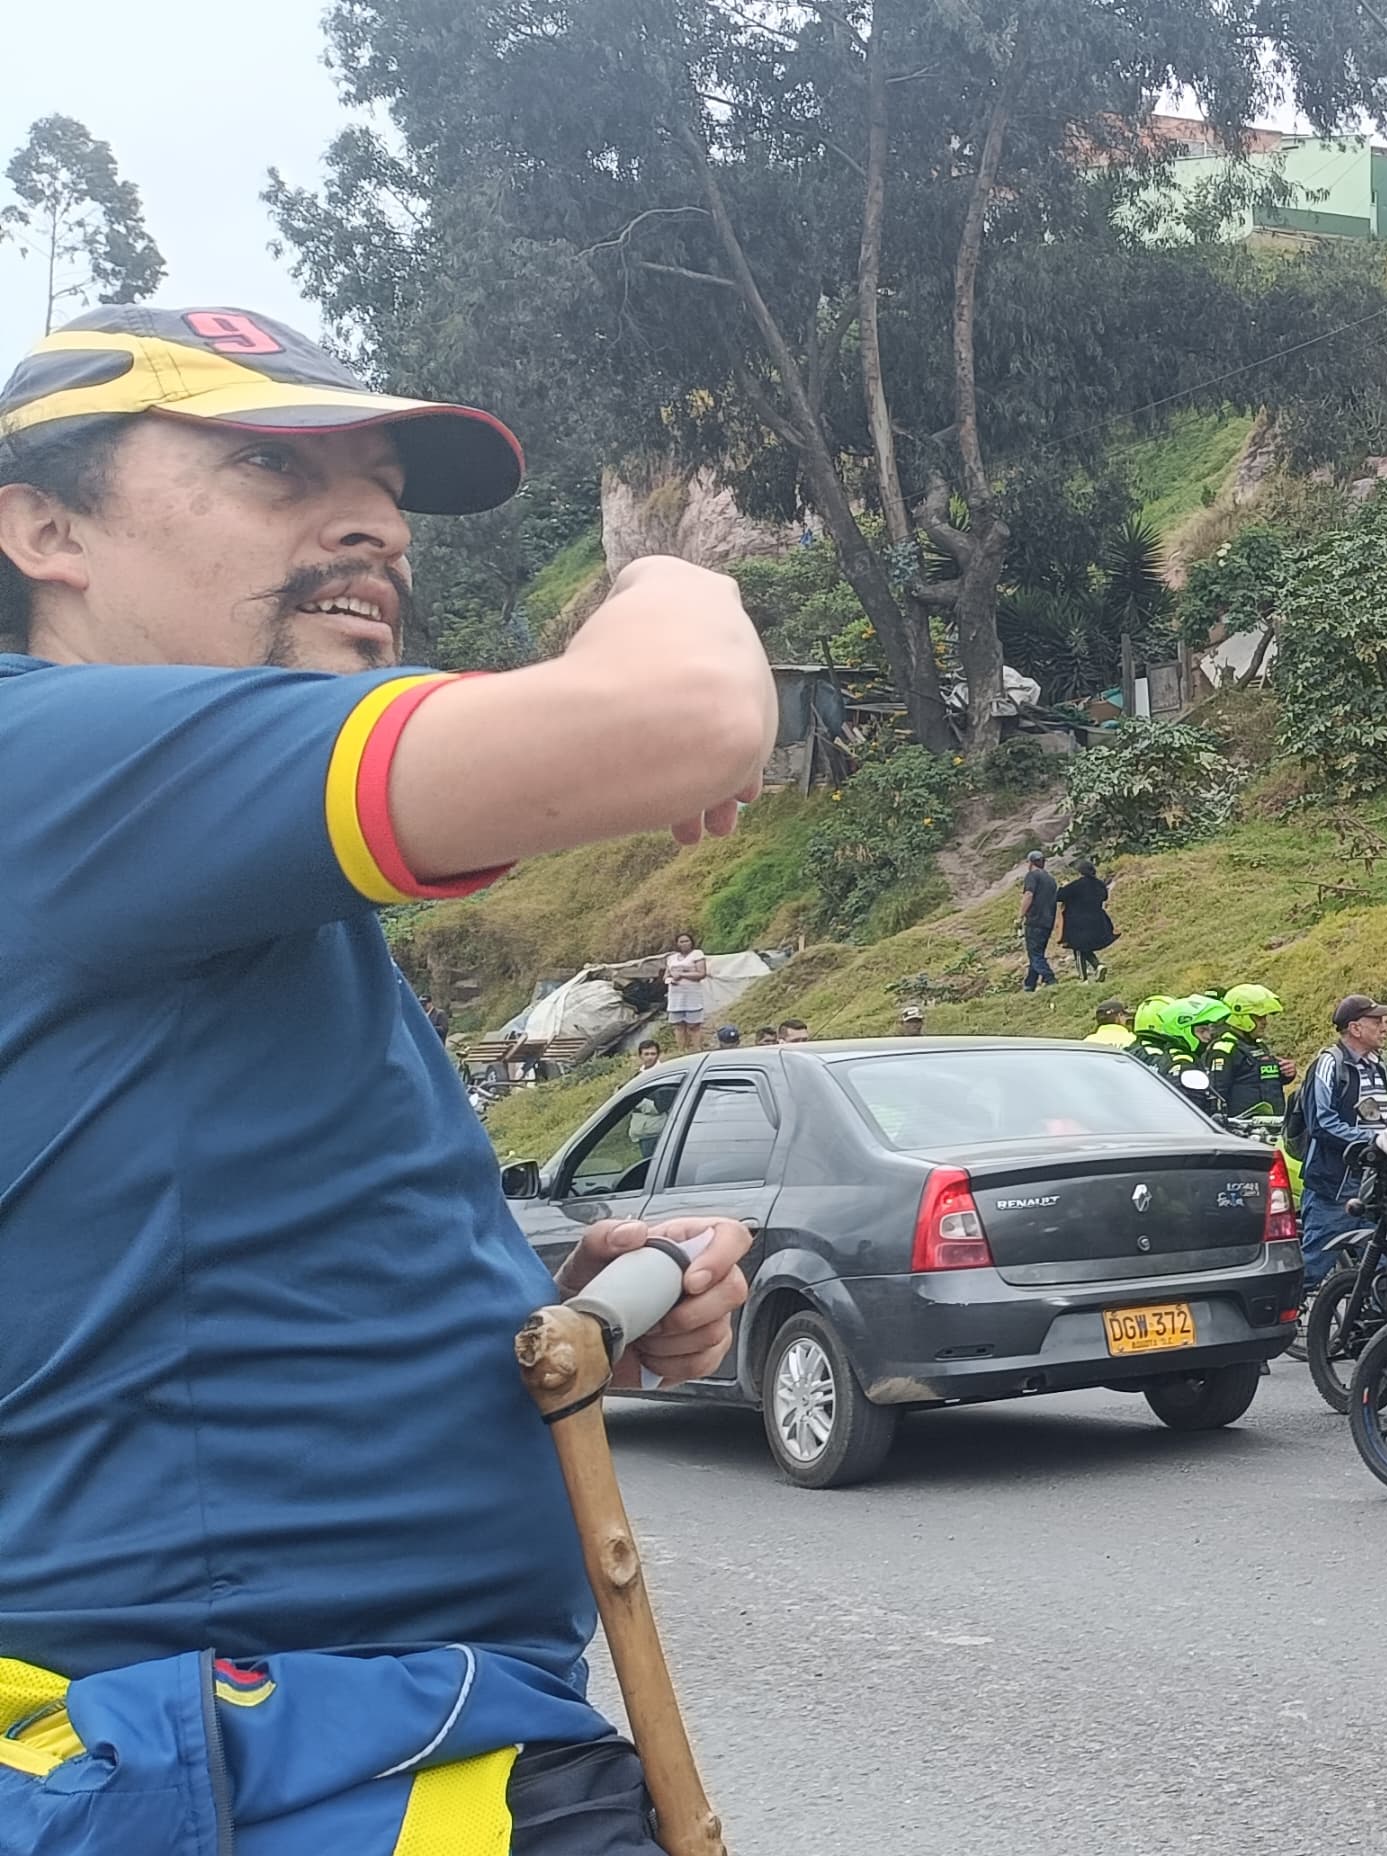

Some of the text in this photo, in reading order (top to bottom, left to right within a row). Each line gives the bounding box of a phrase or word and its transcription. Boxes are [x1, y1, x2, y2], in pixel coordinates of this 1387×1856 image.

[183, 312, 286, 354] 9
[997, 1195, 1060, 1210] RENAULT
[1152, 1310, 1191, 1336] 372
